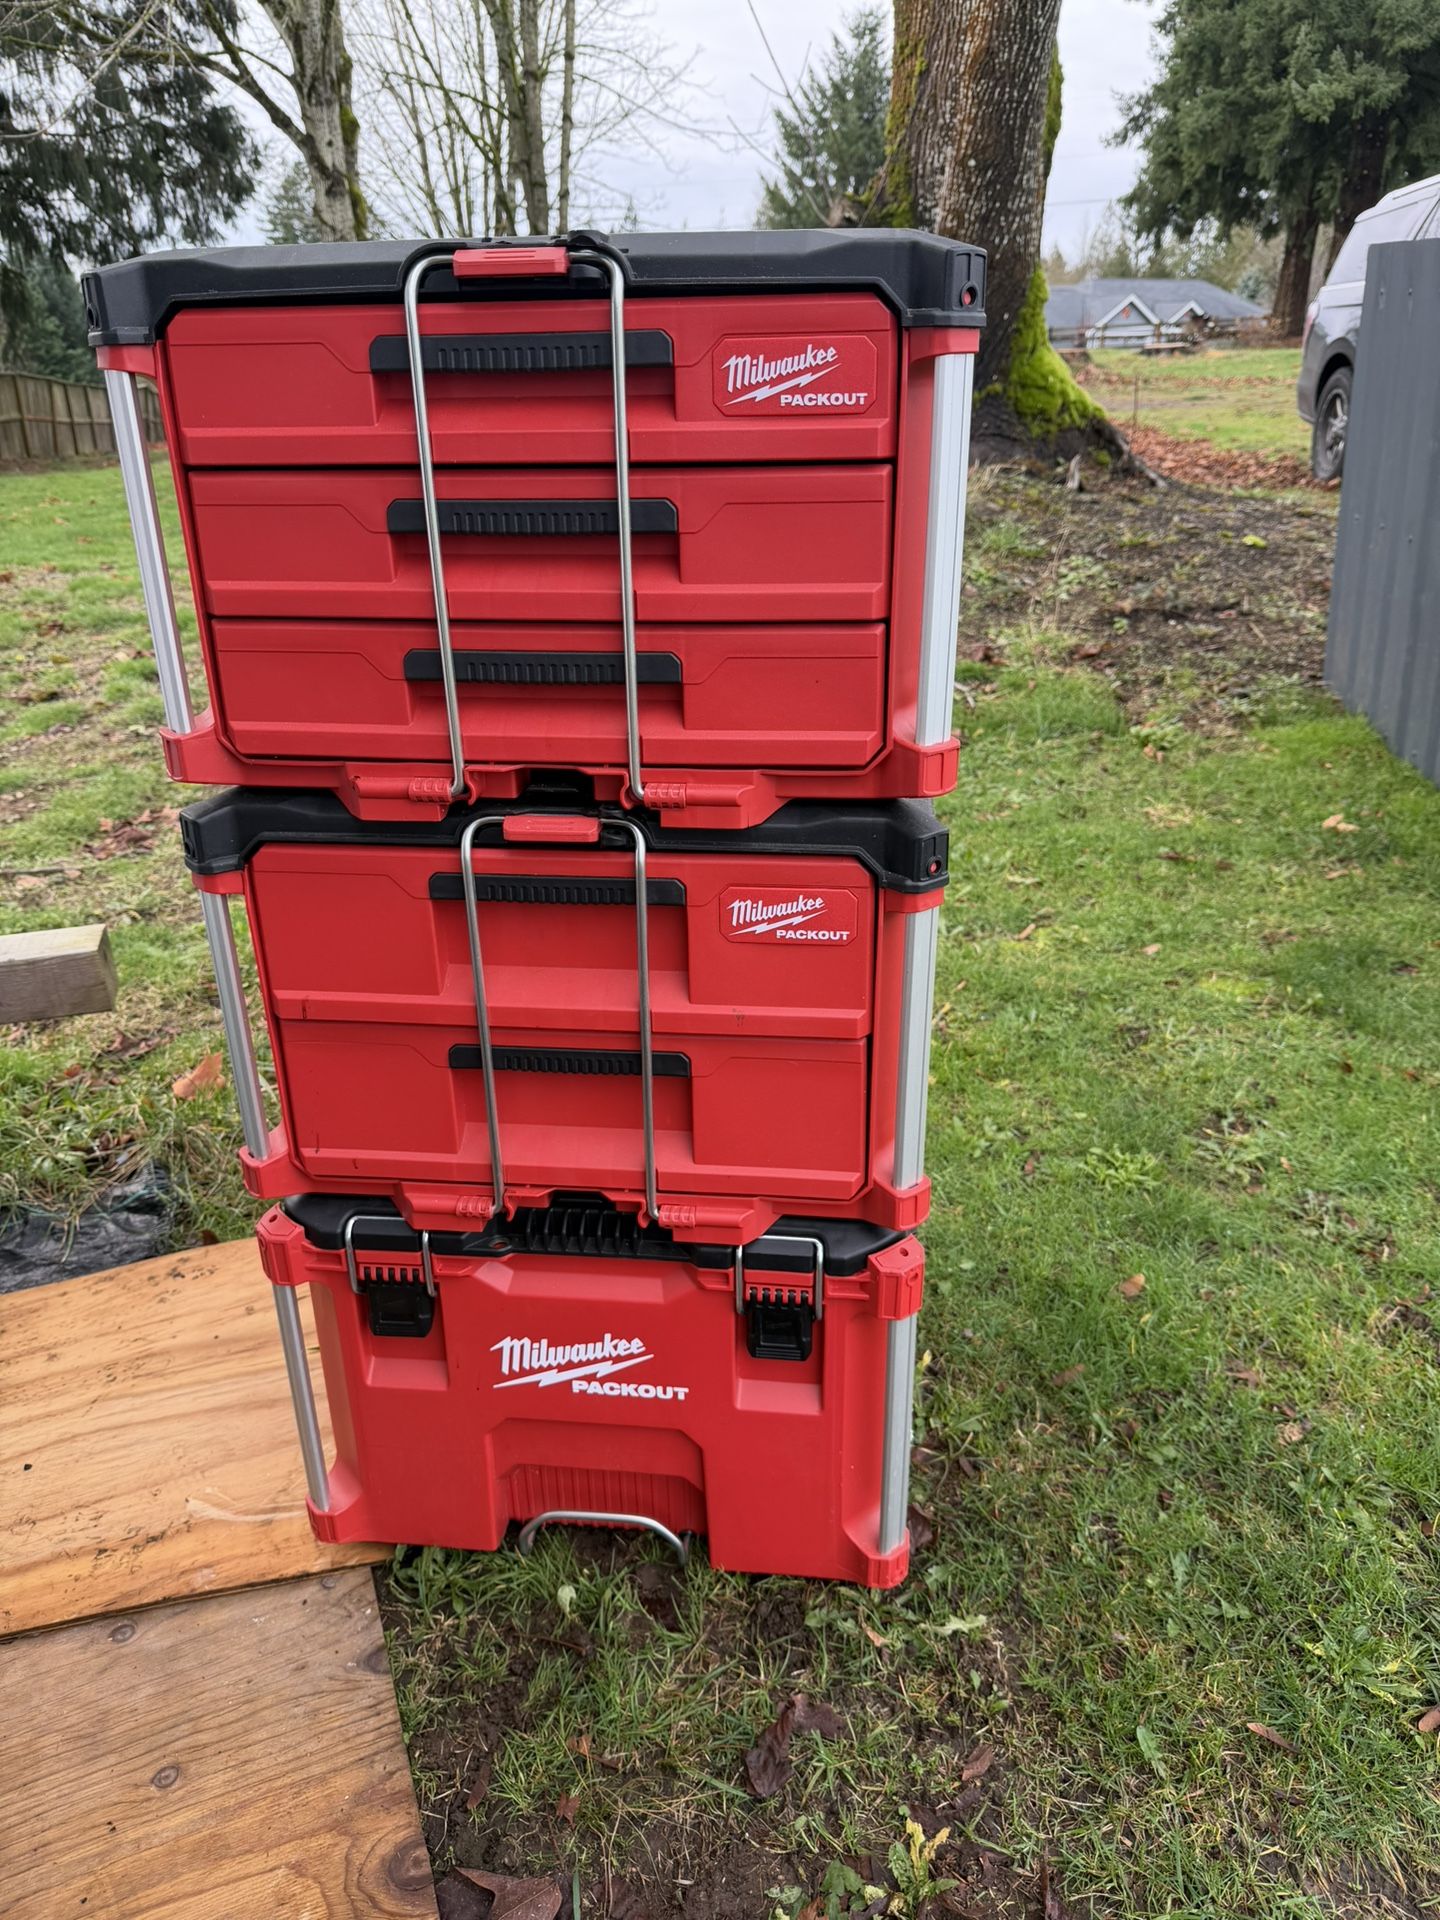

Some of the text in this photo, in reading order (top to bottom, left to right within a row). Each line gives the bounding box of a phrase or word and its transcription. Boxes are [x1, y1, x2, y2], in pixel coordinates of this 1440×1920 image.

[721, 343, 838, 392] Milwaukee
[781, 392, 868, 407] PACKOUT
[727, 894, 824, 926] Milwaukee
[776, 929, 850, 941] PACKOUT
[490, 1333, 645, 1375] Milwaukee
[571, 1379, 690, 1401] PACKOUT
